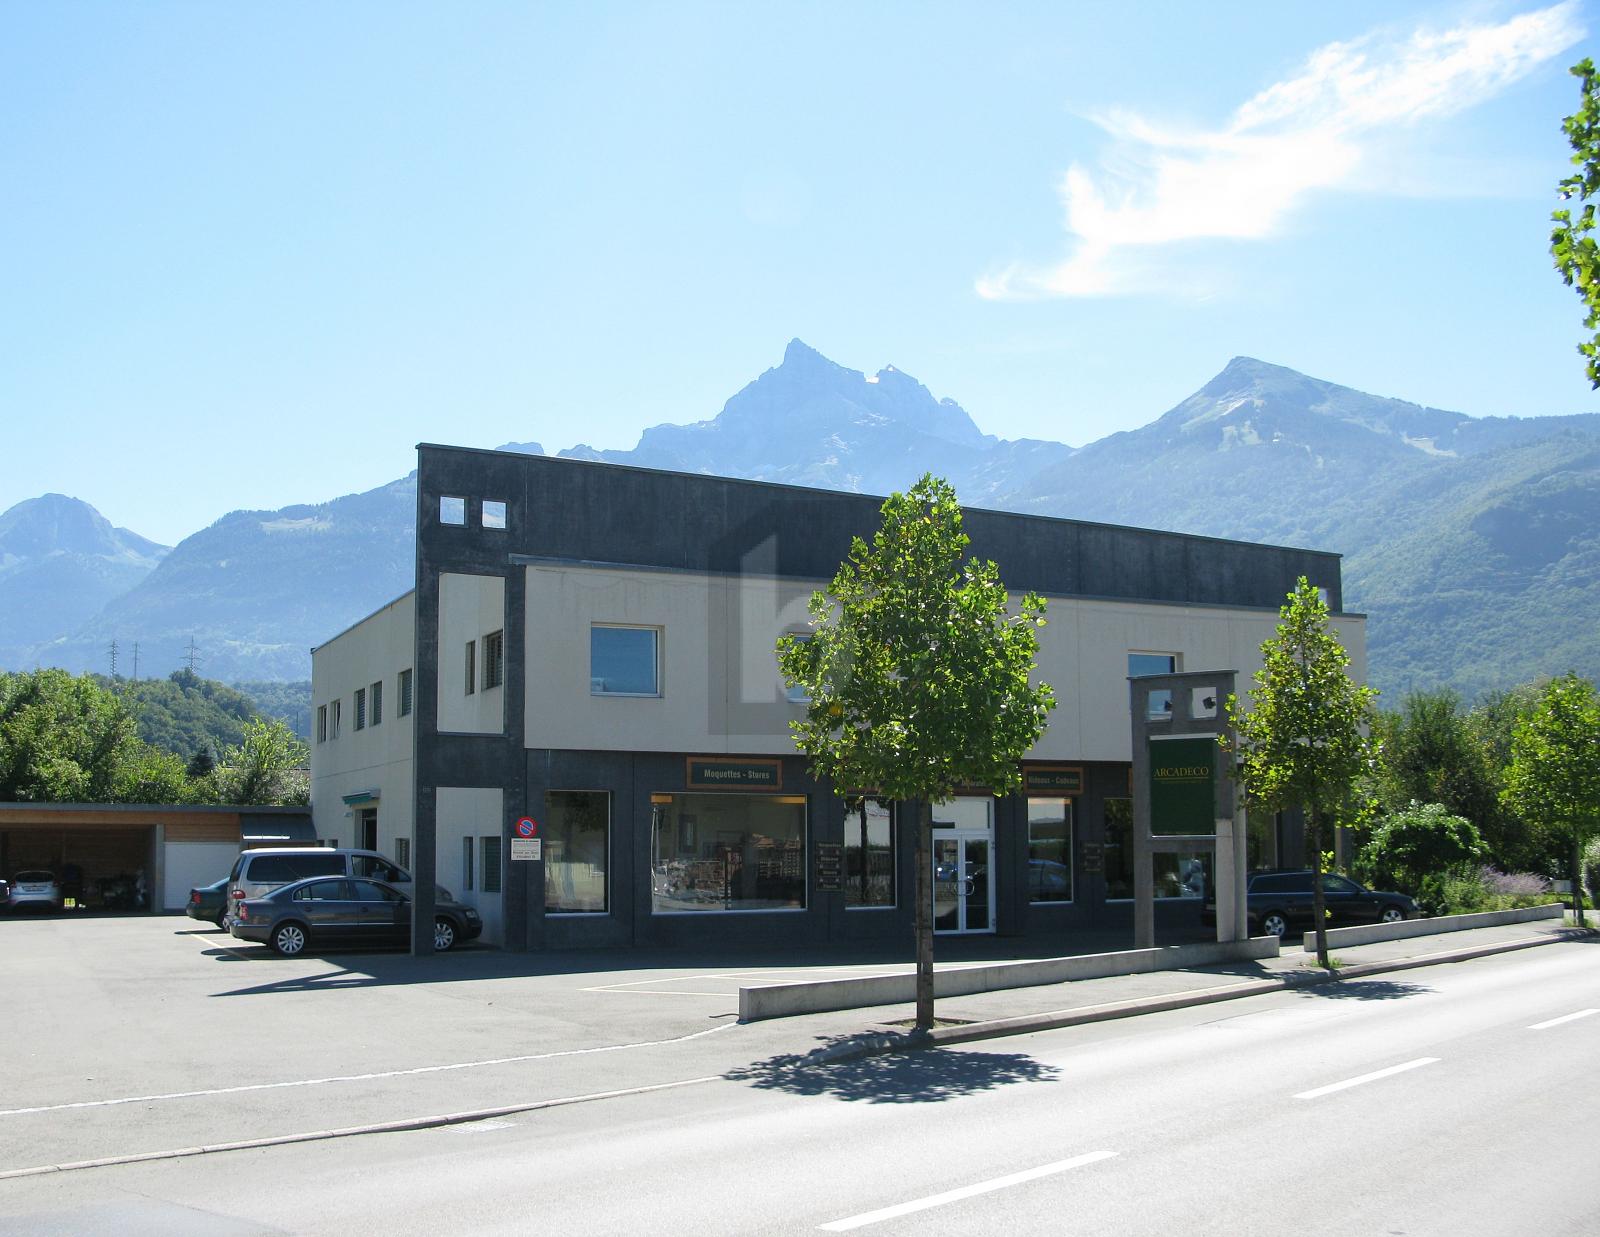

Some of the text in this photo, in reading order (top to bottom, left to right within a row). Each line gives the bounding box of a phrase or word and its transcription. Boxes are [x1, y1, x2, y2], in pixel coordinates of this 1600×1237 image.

[704, 769, 741, 779] Moquettes
[748, 770, 770, 779] Stores
[1152, 766, 1209, 777] ARCADECO
